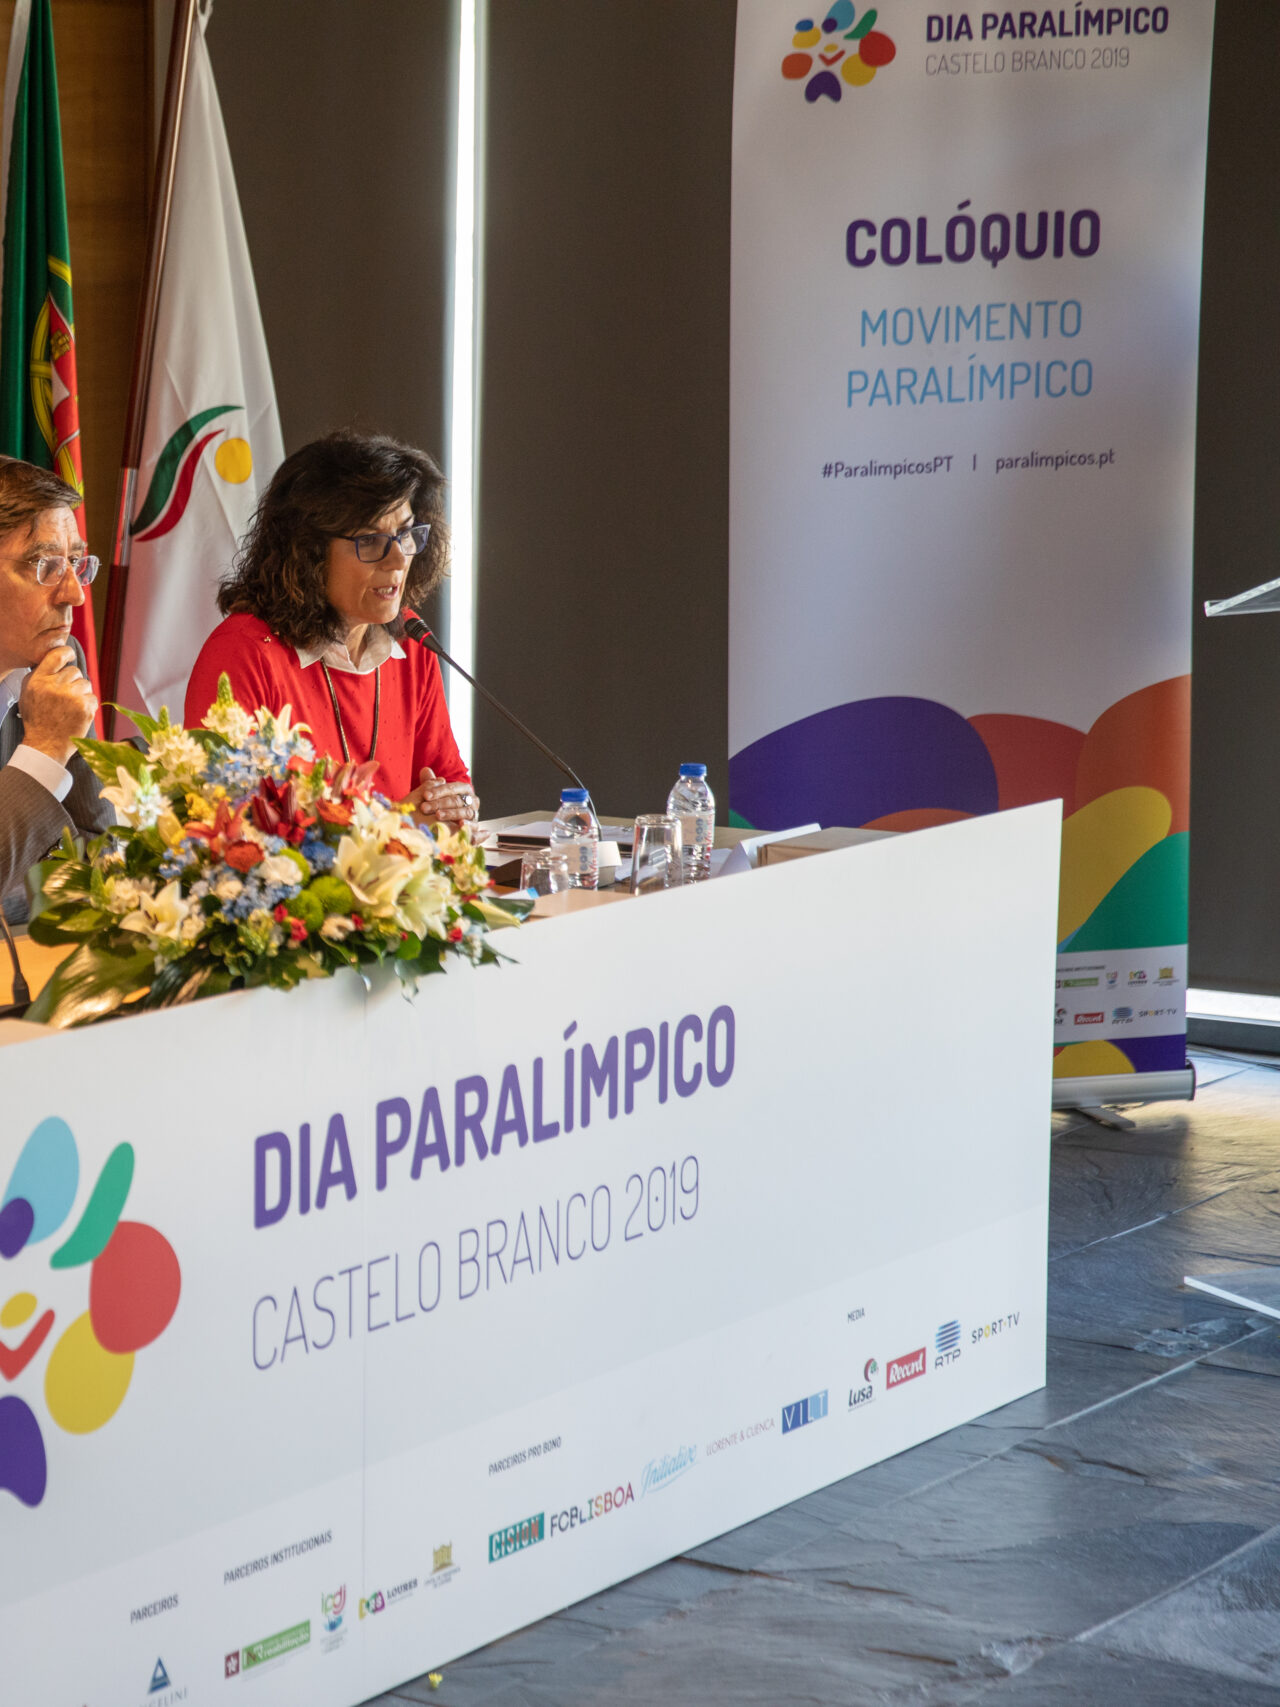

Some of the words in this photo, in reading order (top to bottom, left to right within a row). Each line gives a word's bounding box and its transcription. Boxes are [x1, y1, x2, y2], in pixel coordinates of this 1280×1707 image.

[926, 13, 974, 43] DIA
[981, 1, 1170, 40] PARALÍMPICO
[925, 51, 1006, 76] CASTELO
[1012, 49, 1087, 73] BRANCO
[1091, 47, 1131, 69] 2019
[845, 199, 1101, 268] COLÓQUIO
[860, 300, 1083, 347] MOVIMENTO
[846, 354, 1094, 408] PARALÍMPICO
[822, 455, 954, 480] #ParalimpicosPT
[995, 449, 1116, 473] paralimpicos.pt
[254, 1112, 357, 1230] DIA
[376, 1004, 736, 1192] PARALÍMPICO
[253, 1241, 441, 1371] CASTELO
[458, 1185, 611, 1300] BRANCO
[624, 1156, 699, 1242] 2019
[847, 1307, 865, 1323] MEDIA
[888, 1351, 924, 1385] Record
[935, 1349, 961, 1369] RTP
[488, 1452, 527, 1476] PARCEIROS
[527, 1444, 542, 1459] PRO
[543, 1436, 561, 1452] BONO
[224, 1556, 269, 1586] PARCEIROS
[270, 1530, 332, 1566] INSTITUCIONAIS
[130, 1594, 179, 1624] PARCEIROS
[386, 1579, 418, 1600] LOURES
